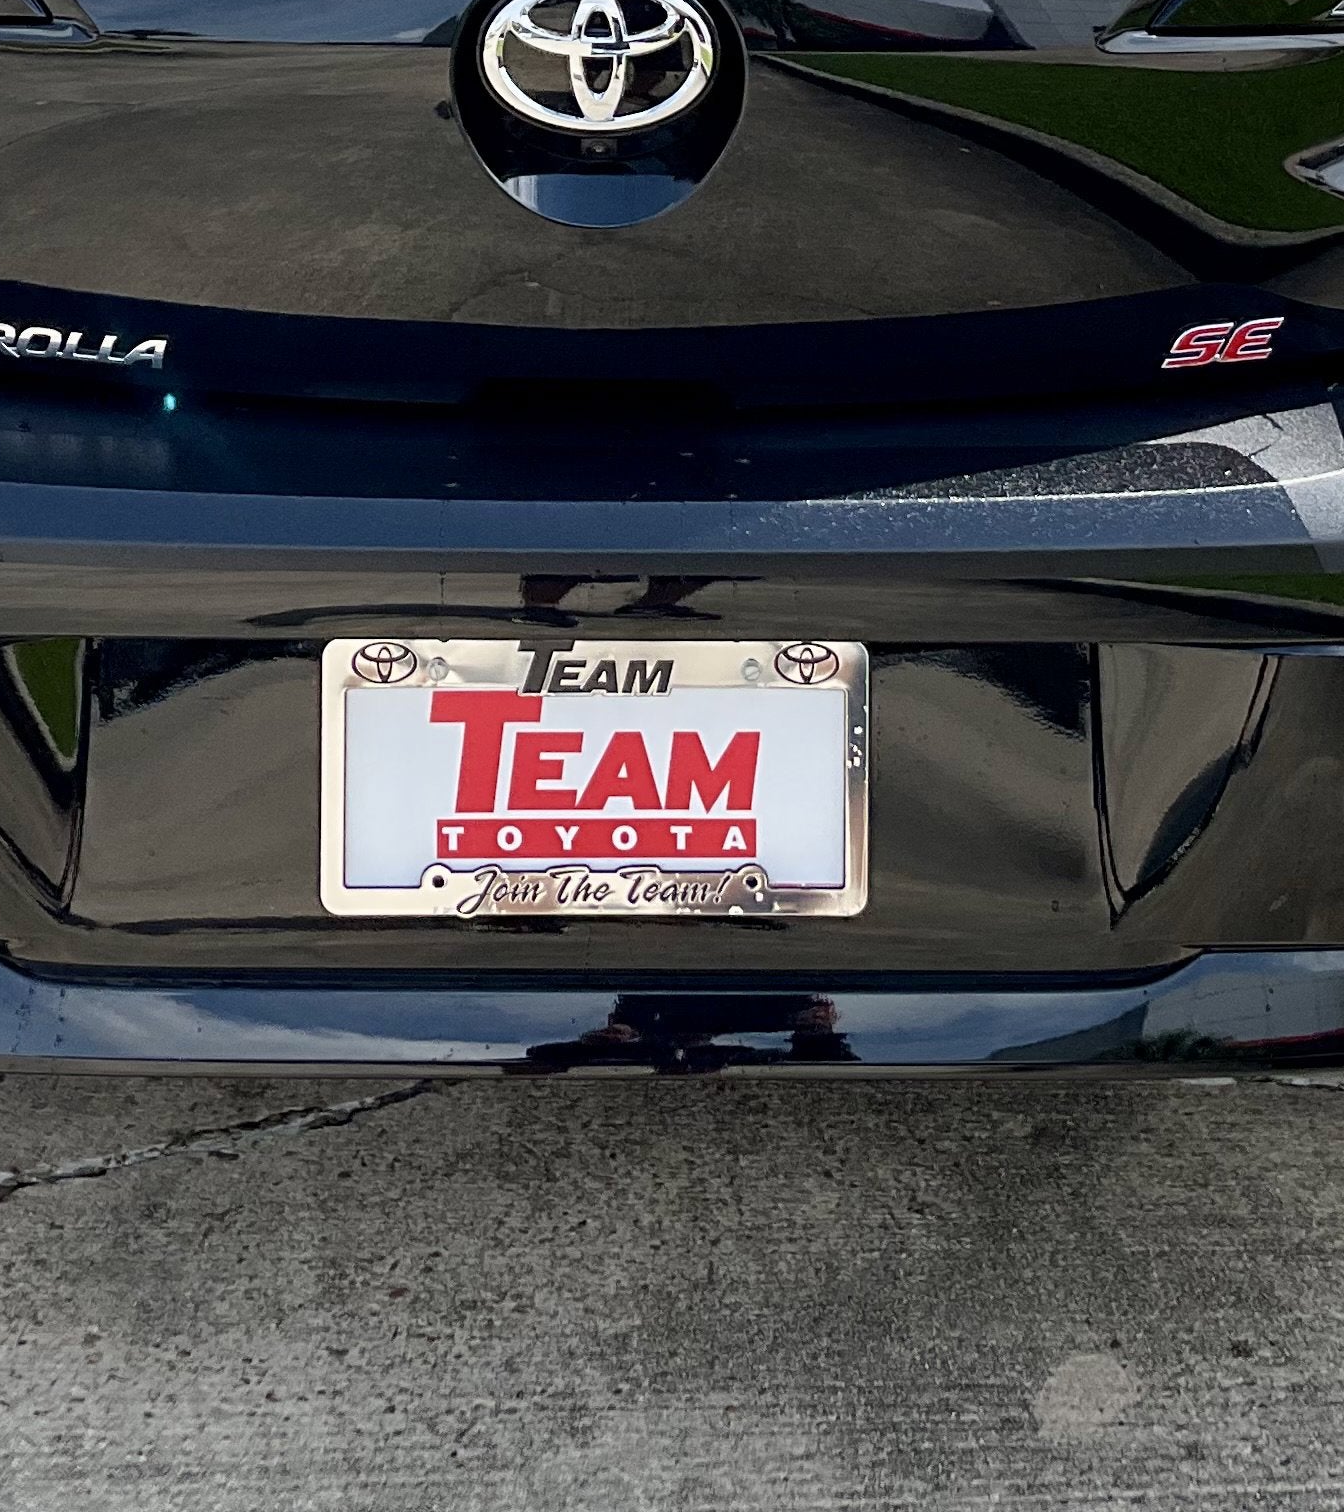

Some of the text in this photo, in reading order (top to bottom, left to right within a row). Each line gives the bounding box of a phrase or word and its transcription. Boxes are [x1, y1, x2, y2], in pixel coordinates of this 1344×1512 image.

[1160, 317, 1285, 369] SE
[517, 639, 674, 695] TEAM
[429, 690, 762, 814] TEAM
[441, 825, 748, 851] TOYOTA
[455, 868, 731, 915] Join The Team!
